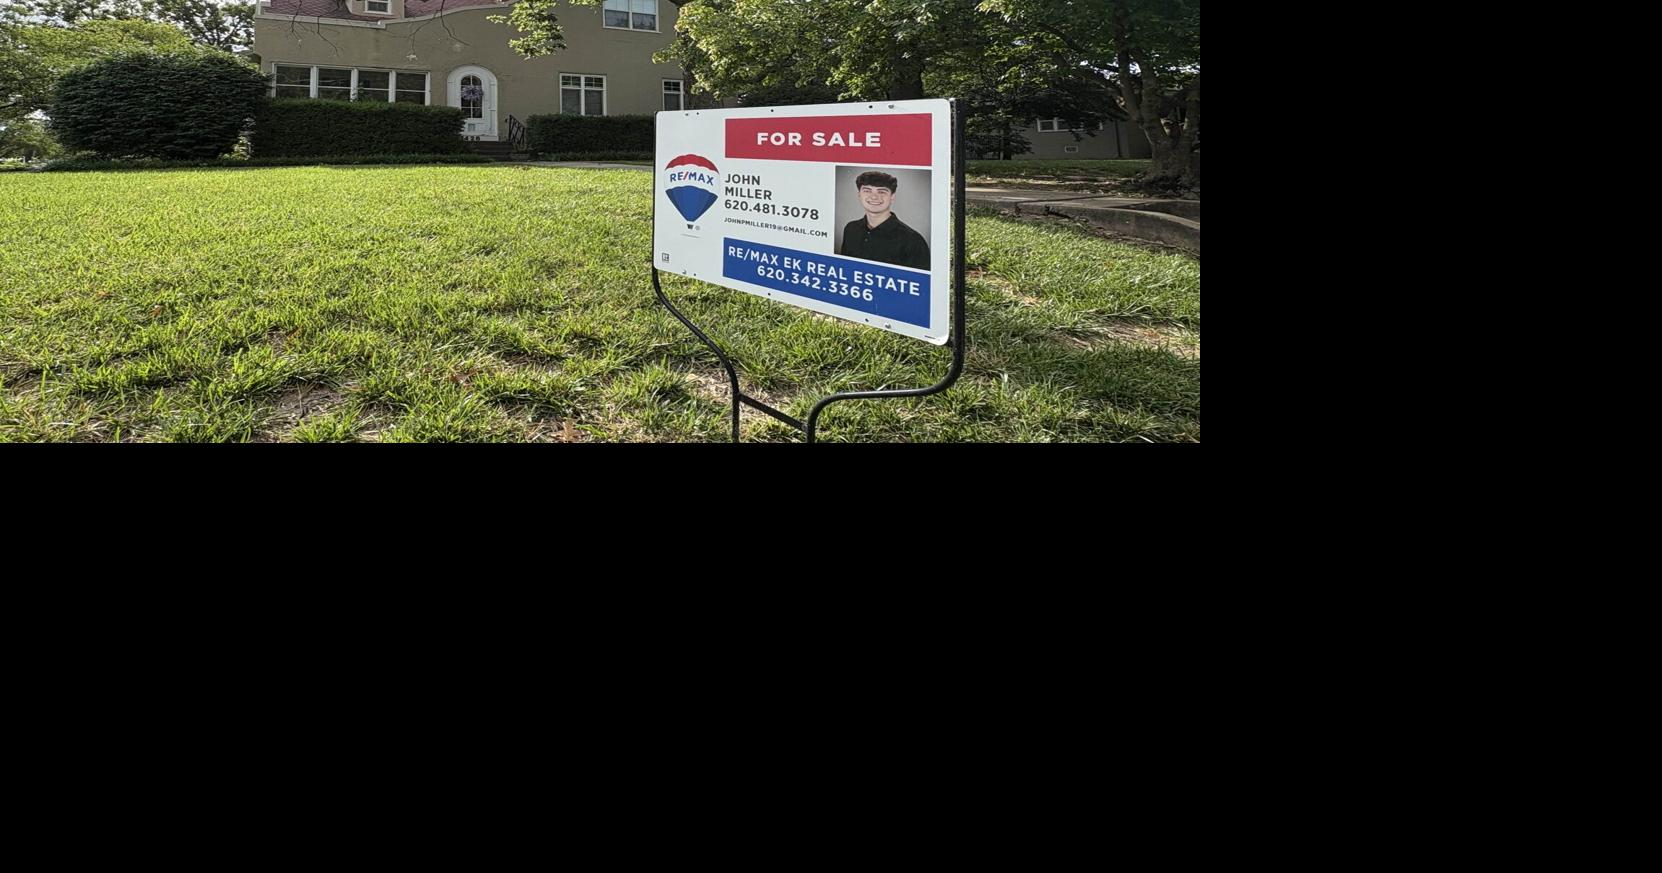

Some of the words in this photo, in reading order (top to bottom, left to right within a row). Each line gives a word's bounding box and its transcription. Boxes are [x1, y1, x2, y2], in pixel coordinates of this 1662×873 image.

[757, 132, 802, 146] FOR
[812, 132, 881, 147] SALE
[669, 171, 714, 186] RE/MAX
[724, 173, 761, 186] JOHN
[724, 186, 772, 201] MILLER
[724, 199, 819, 220] 620.481.3078
[723, 217, 828, 238] JOHNPMILLER19@GMAIL.COM
[728, 245, 778, 266] RE/MAX
[783, 256, 801, 271] EK
[807, 261, 847, 280] REAL
[853, 270, 920, 297] ESTATE
[757, 265, 874, 302] 620.342.3366
